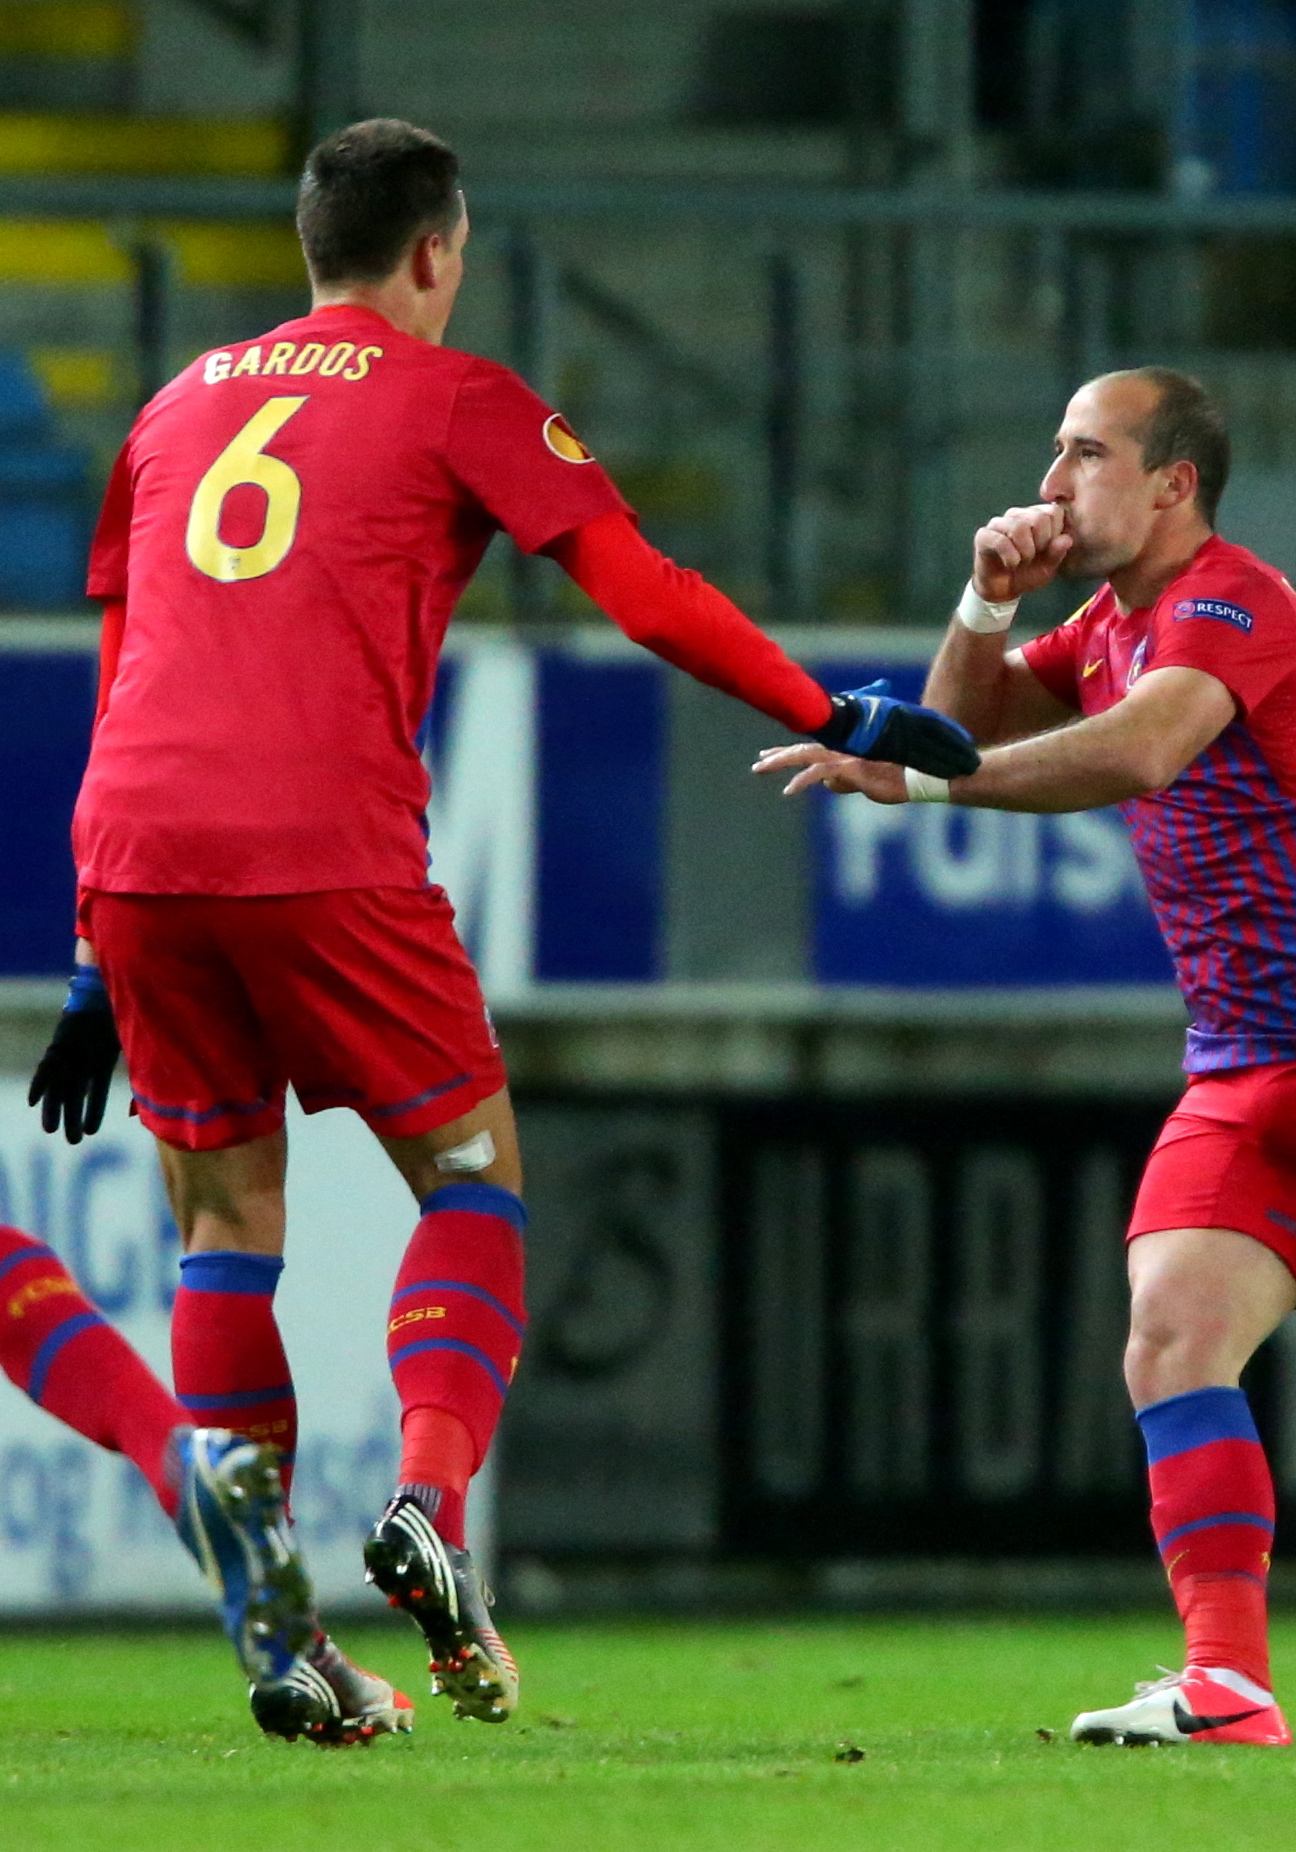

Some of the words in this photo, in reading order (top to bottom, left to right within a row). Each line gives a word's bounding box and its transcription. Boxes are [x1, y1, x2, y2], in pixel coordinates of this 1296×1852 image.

[202, 341, 385, 386] GARDOS
[185, 395, 309, 584] 6
[1196, 602, 1253, 629] RESPECT
[386, 1306, 448, 1337] CSB
